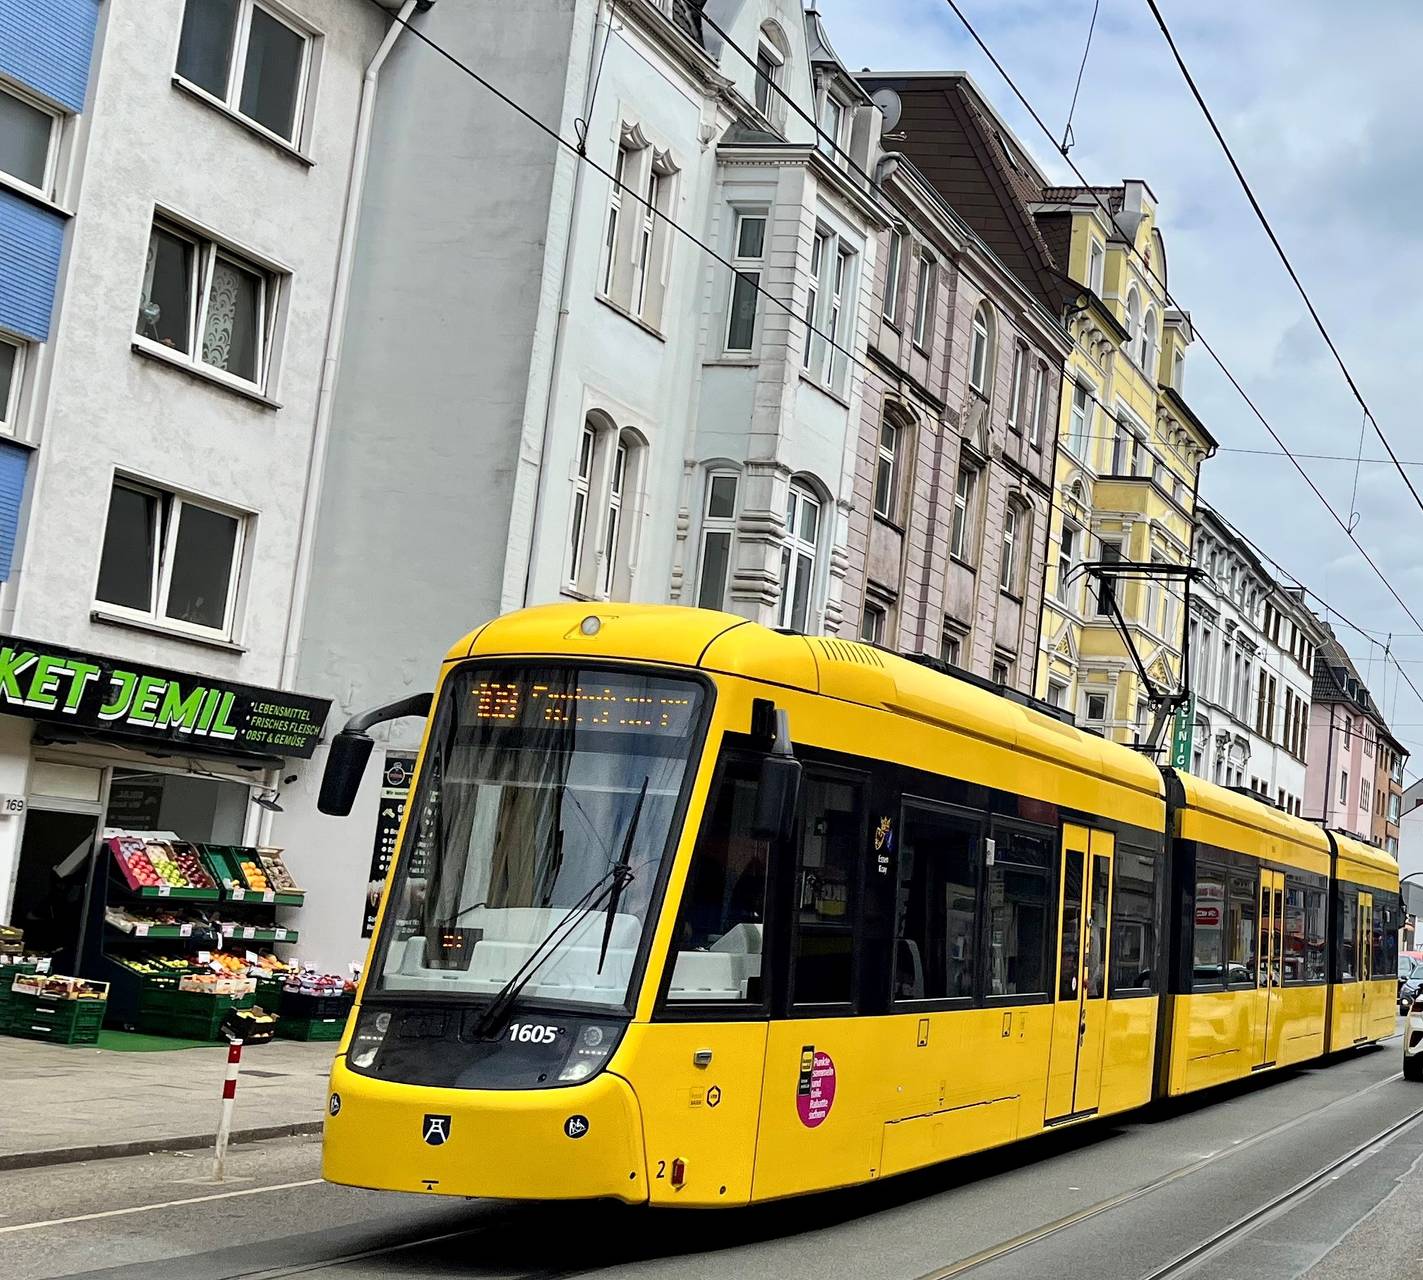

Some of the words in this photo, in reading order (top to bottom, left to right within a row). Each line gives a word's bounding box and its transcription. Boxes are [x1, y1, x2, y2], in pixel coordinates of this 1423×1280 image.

[98, 670, 239, 741] JEMIL
[253, 702, 310, 721] LEBENSMITTEL
[251, 716, 289, 731] FRISCHES
[289, 722, 320, 735] FLEISCH
[246, 730, 267, 741] OBST
[267, 733, 273, 743] &
[275, 734, 307, 748] GEMÜSE
[6, 799, 24, 811] 169
[508, 1023, 557, 1044] 1605
[656, 1161, 666, 1178] 2
